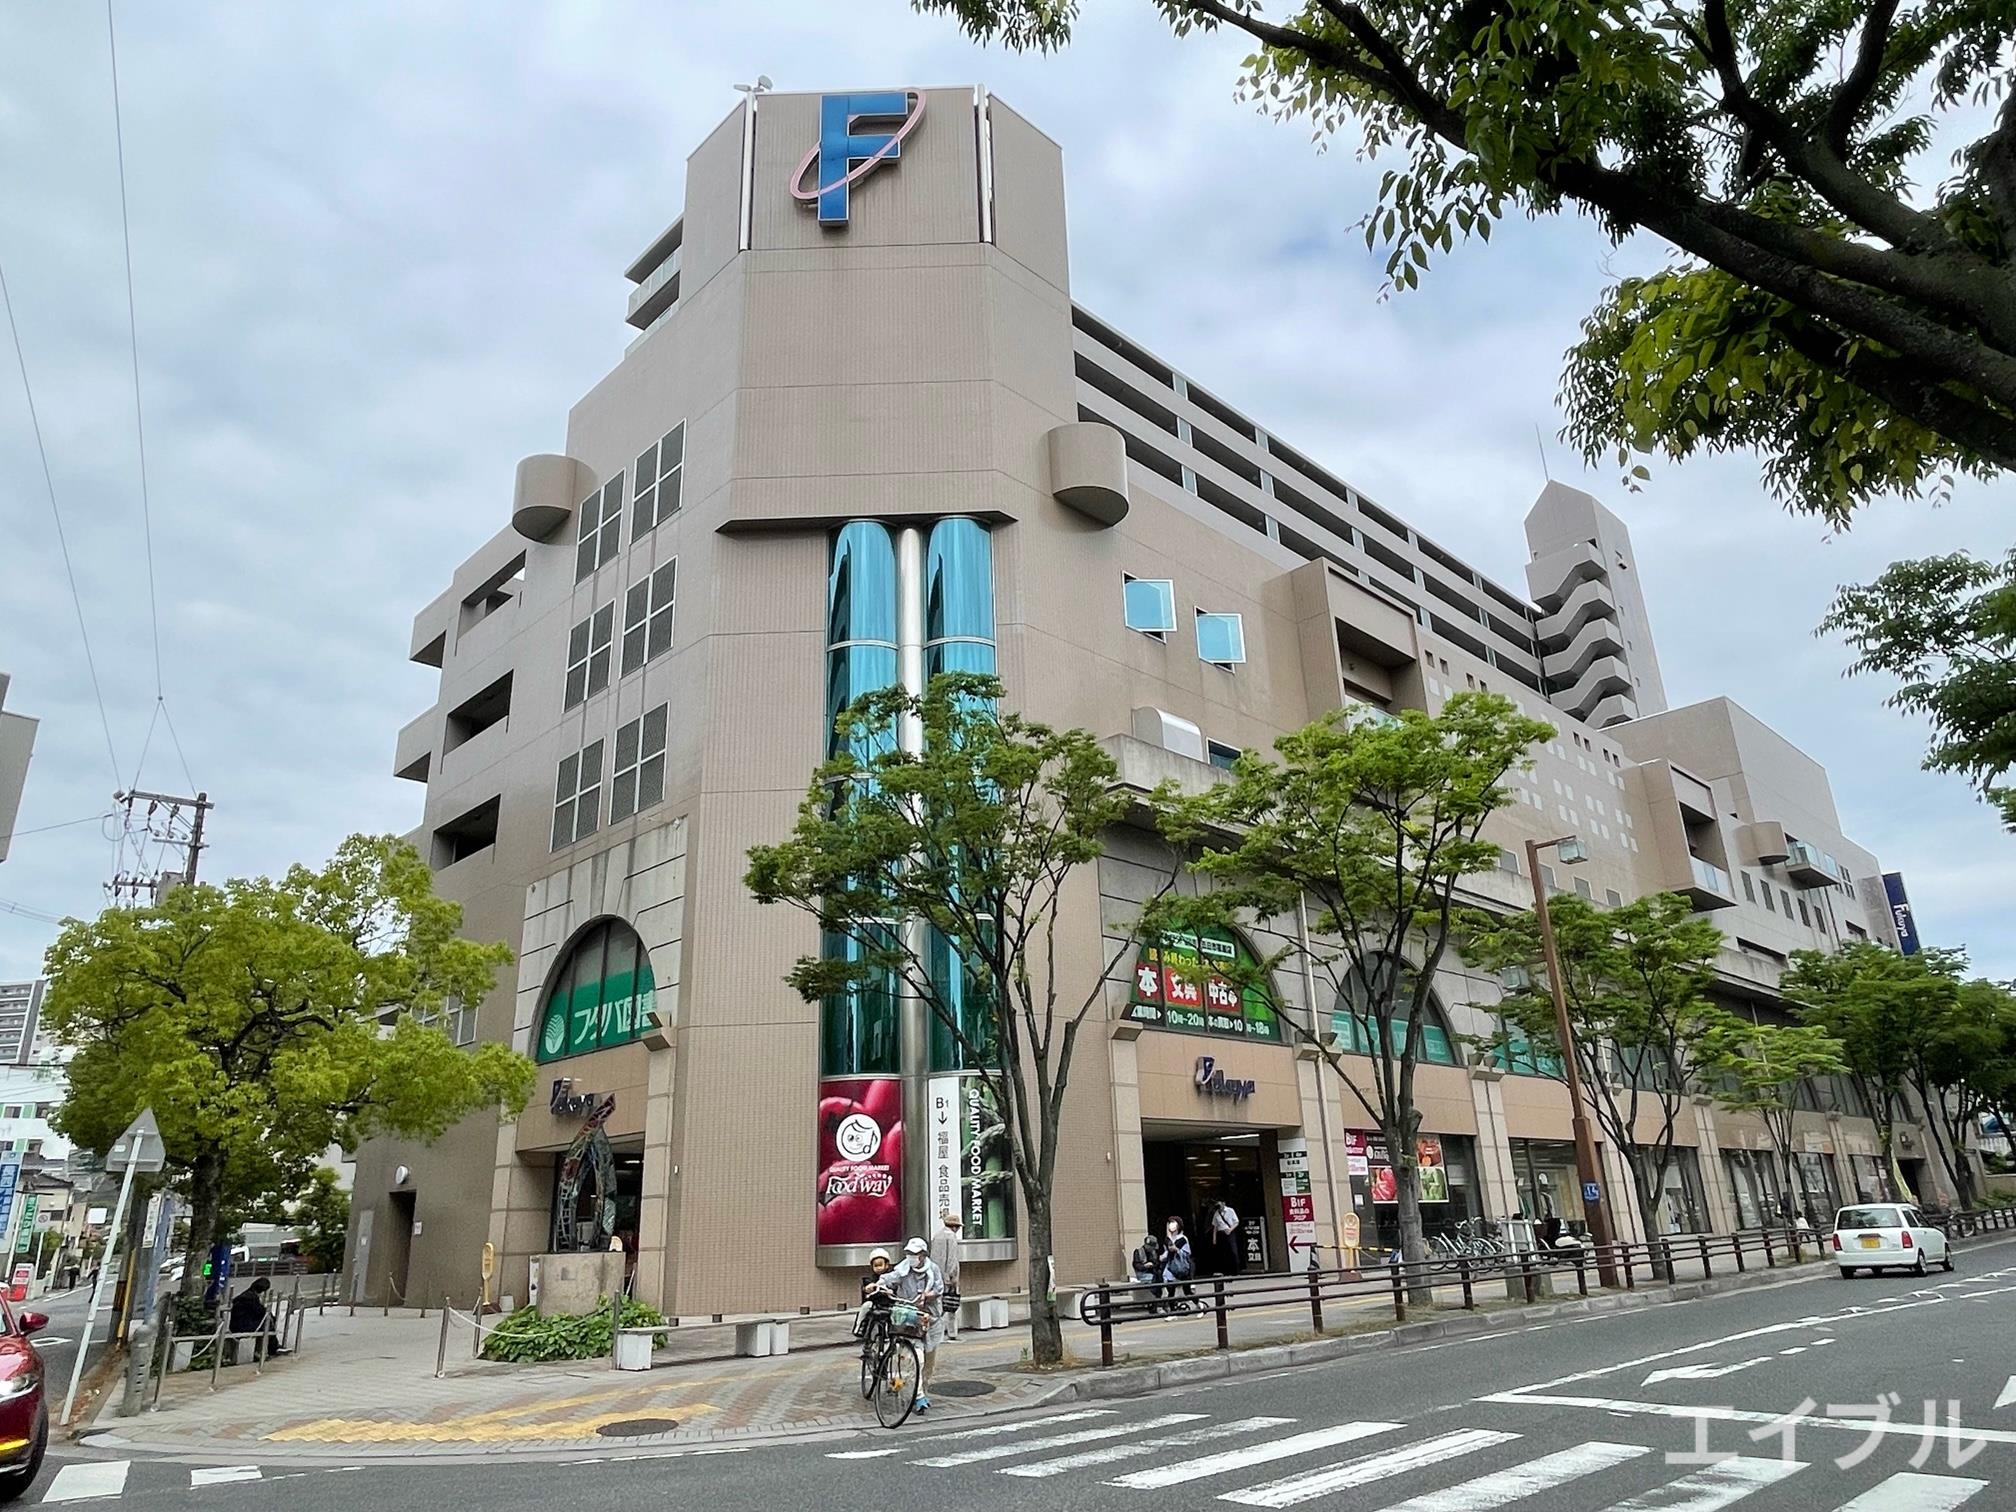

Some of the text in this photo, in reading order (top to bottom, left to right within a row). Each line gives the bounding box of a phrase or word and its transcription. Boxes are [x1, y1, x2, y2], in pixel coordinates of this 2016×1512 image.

[815, 89, 909, 224] F
[1893, 902, 1910, 937] Fukuya
[1138, 966, 1158, 997] 本
[968, 1088, 983, 1226] QUALITY FOOD MARKET
[1247, 1237, 1260, 1252] 本
